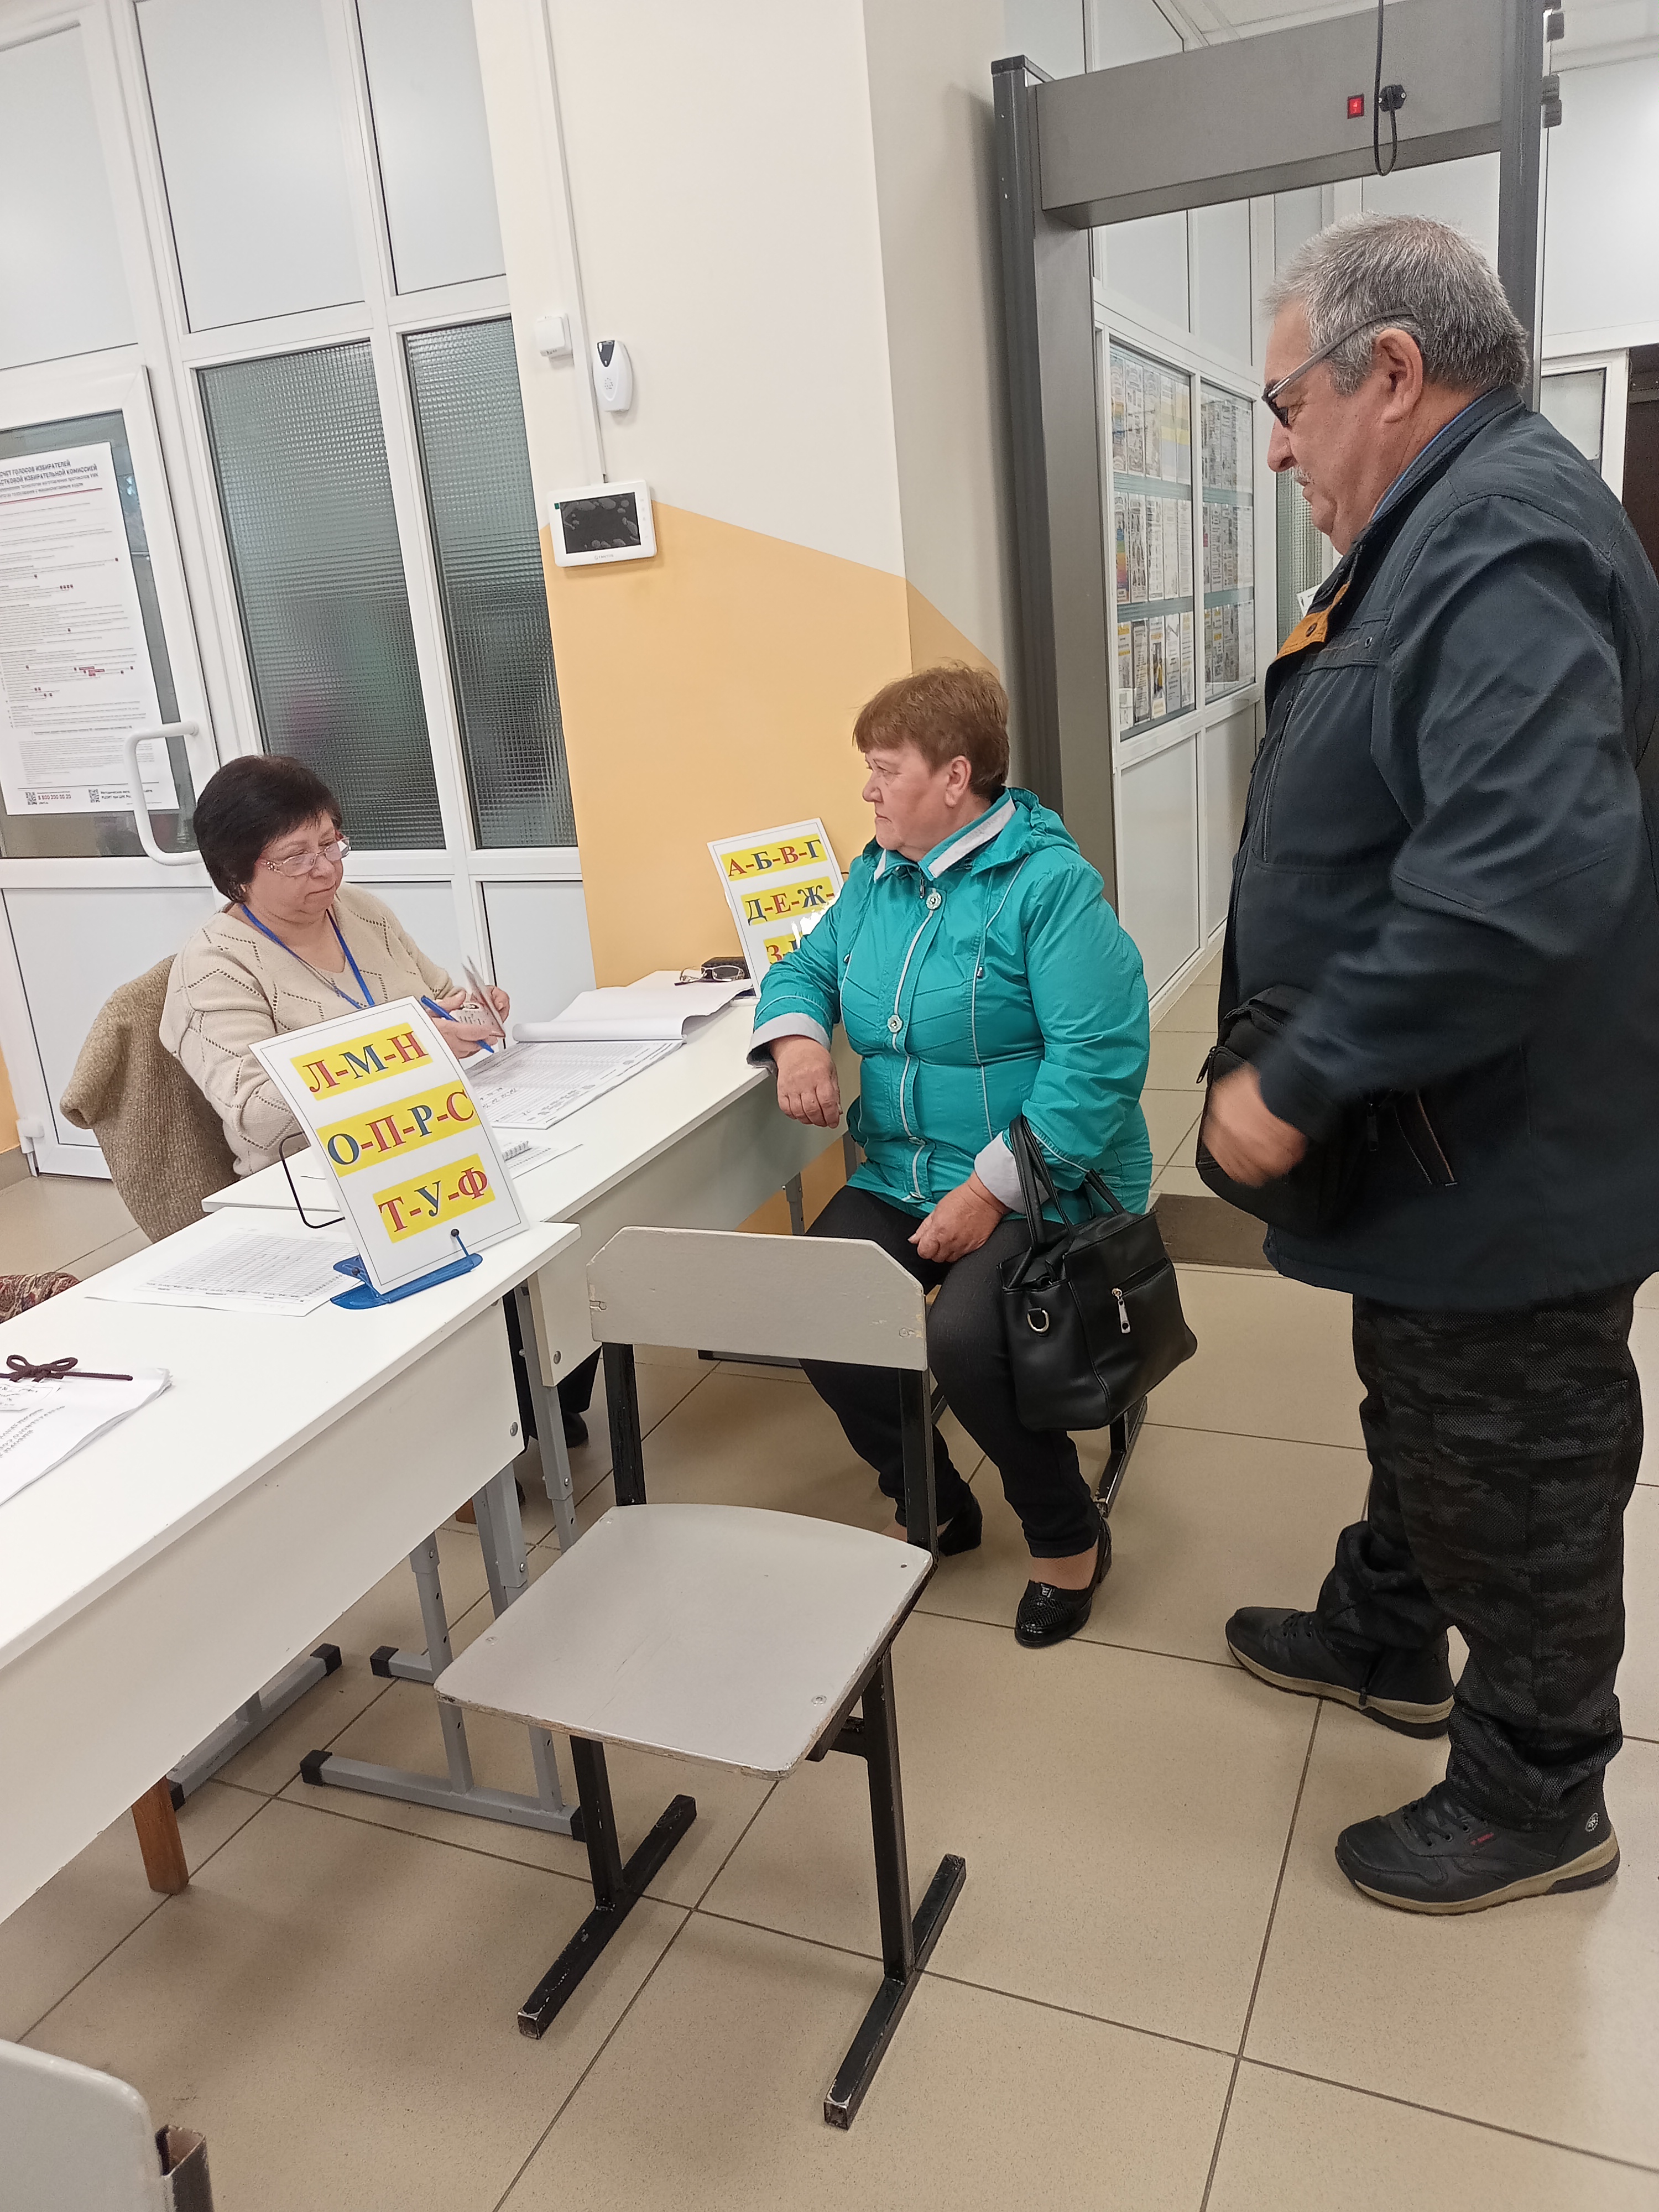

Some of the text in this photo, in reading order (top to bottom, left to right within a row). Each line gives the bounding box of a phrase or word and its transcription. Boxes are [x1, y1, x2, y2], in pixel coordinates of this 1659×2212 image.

[24, 469, 66, 482] ИЗБИРАТЕЛЬНОЙ
[67, 463, 98, 474] КОМИССИЕЙ
[35, 460, 71, 471] ИЗБИРАТЕЛЕЙ
[728, 839, 821, 877] А-Б-В-Г
[302, 1030, 429, 1093] Л-М-Н
[327, 1089, 474, 1165] О-П-Р-С
[378, 1167, 488, 1233] Т-У-Ф
